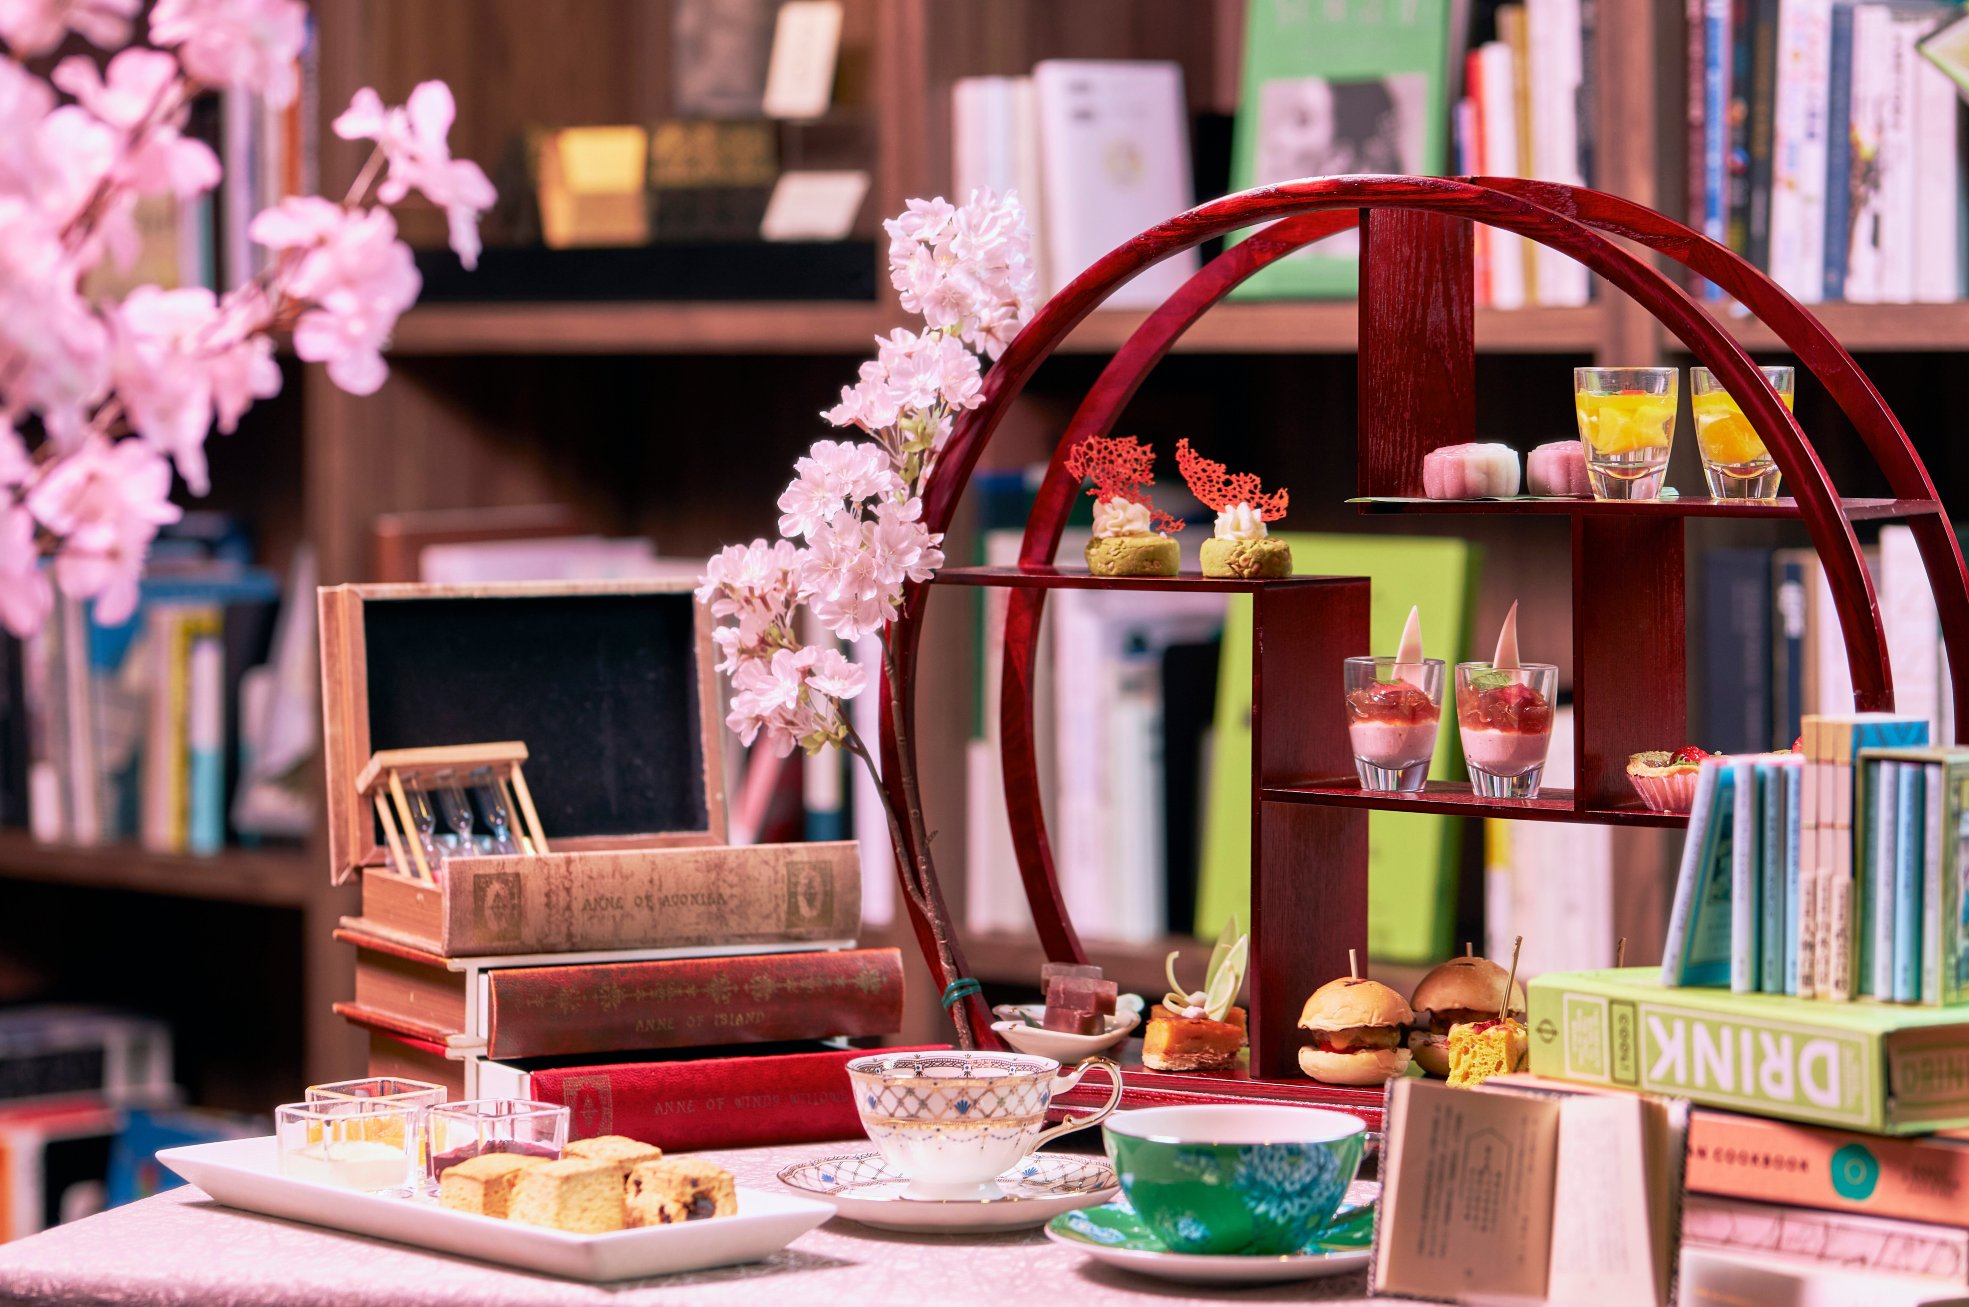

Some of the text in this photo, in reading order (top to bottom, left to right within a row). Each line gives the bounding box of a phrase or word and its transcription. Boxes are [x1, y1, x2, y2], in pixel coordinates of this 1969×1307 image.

[582, 896, 624, 911] ANNE
[635, 1011, 766, 1032] ANNE OF ISLAND
[1647, 1015, 1840, 1108] DRINK
[654, 1099, 695, 1115] ANNE
[706, 1098, 725, 1111] OF
[1713, 1145, 1810, 1173] COOKBOOK
